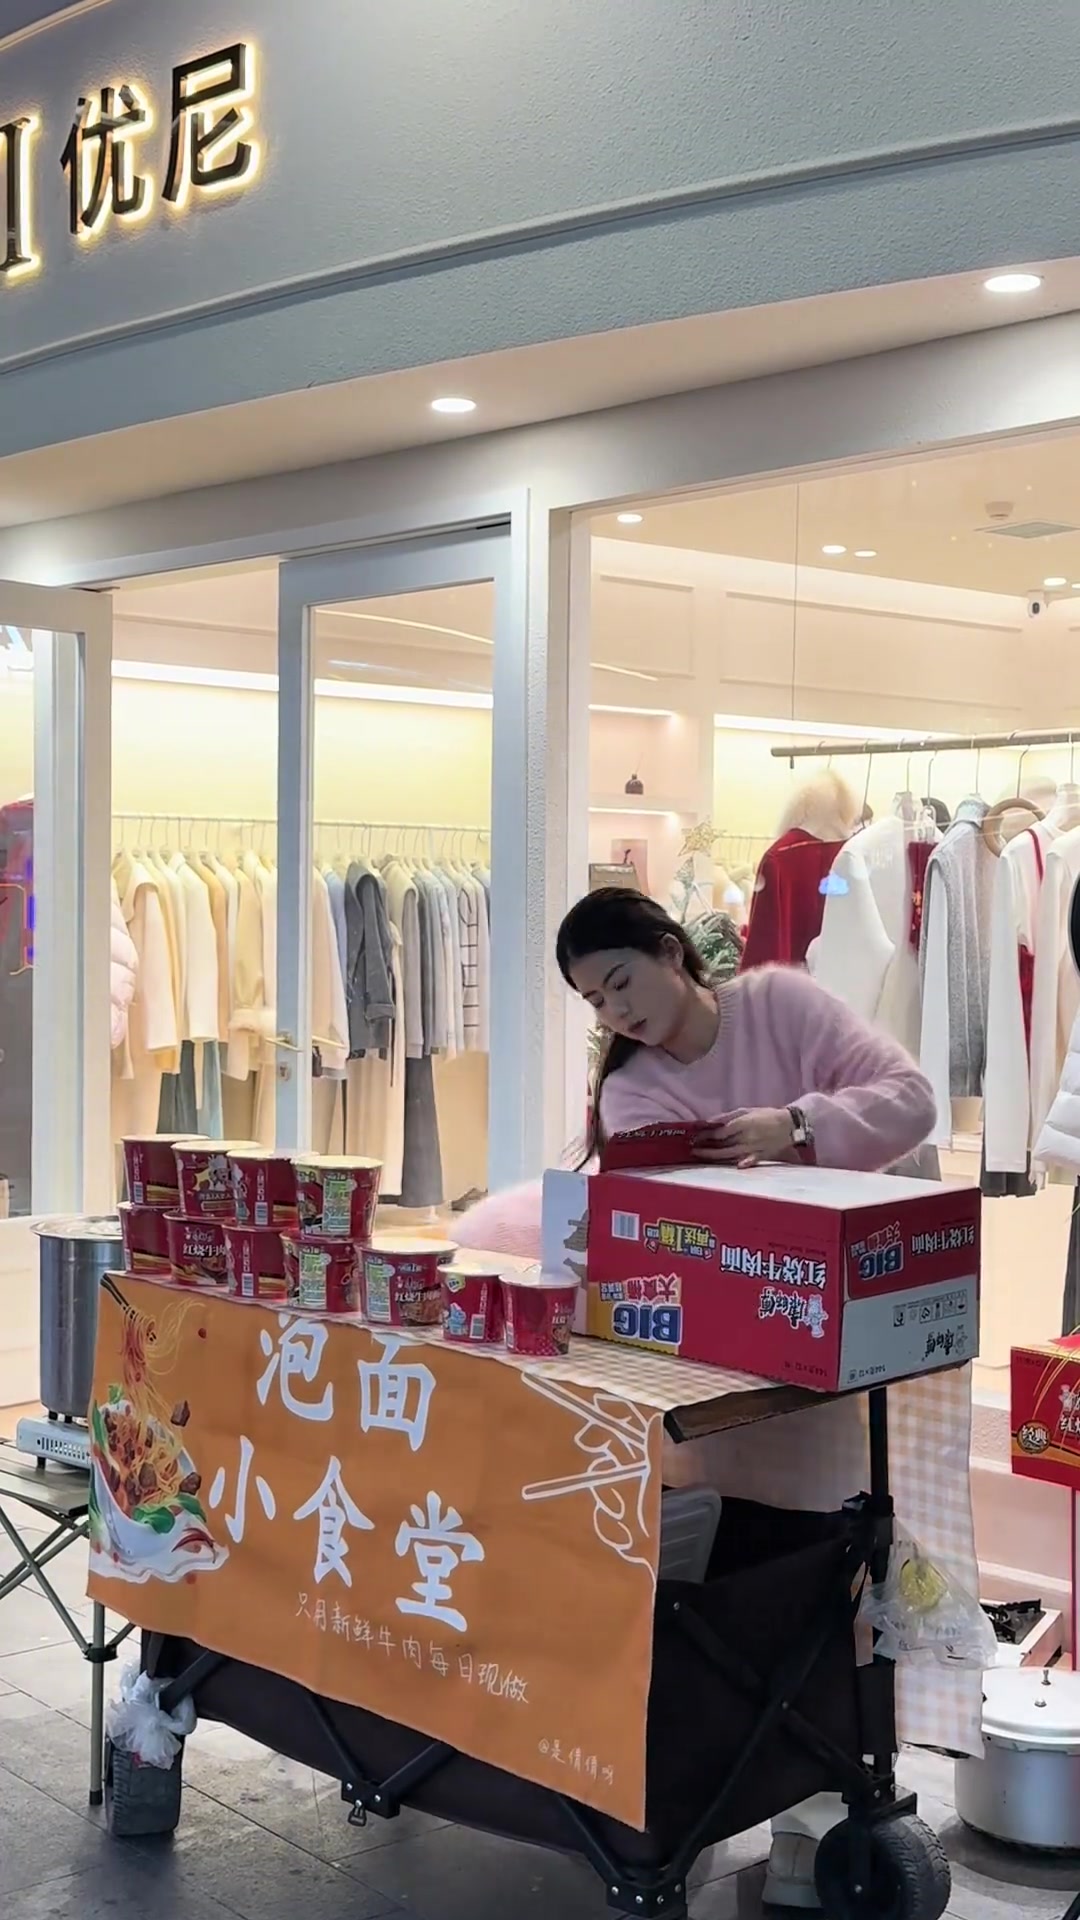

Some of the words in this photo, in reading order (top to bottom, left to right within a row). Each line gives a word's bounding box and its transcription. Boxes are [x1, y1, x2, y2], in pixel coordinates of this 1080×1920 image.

[60, 43, 252, 235] 优尼
[912, 1225, 975, 1256] 红烧牛肉面
[721, 1244, 827, 1289] 红烧牛肉面
[859, 1243, 902, 1279] BIG
[627, 1276, 676, 1302] 大食桶
[613, 1304, 681, 1343] BIG
[256, 1314, 437, 1452] 泡面
[1022, 1425, 1047, 1444] 经典
[208, 1435, 486, 1633] 小食堂
